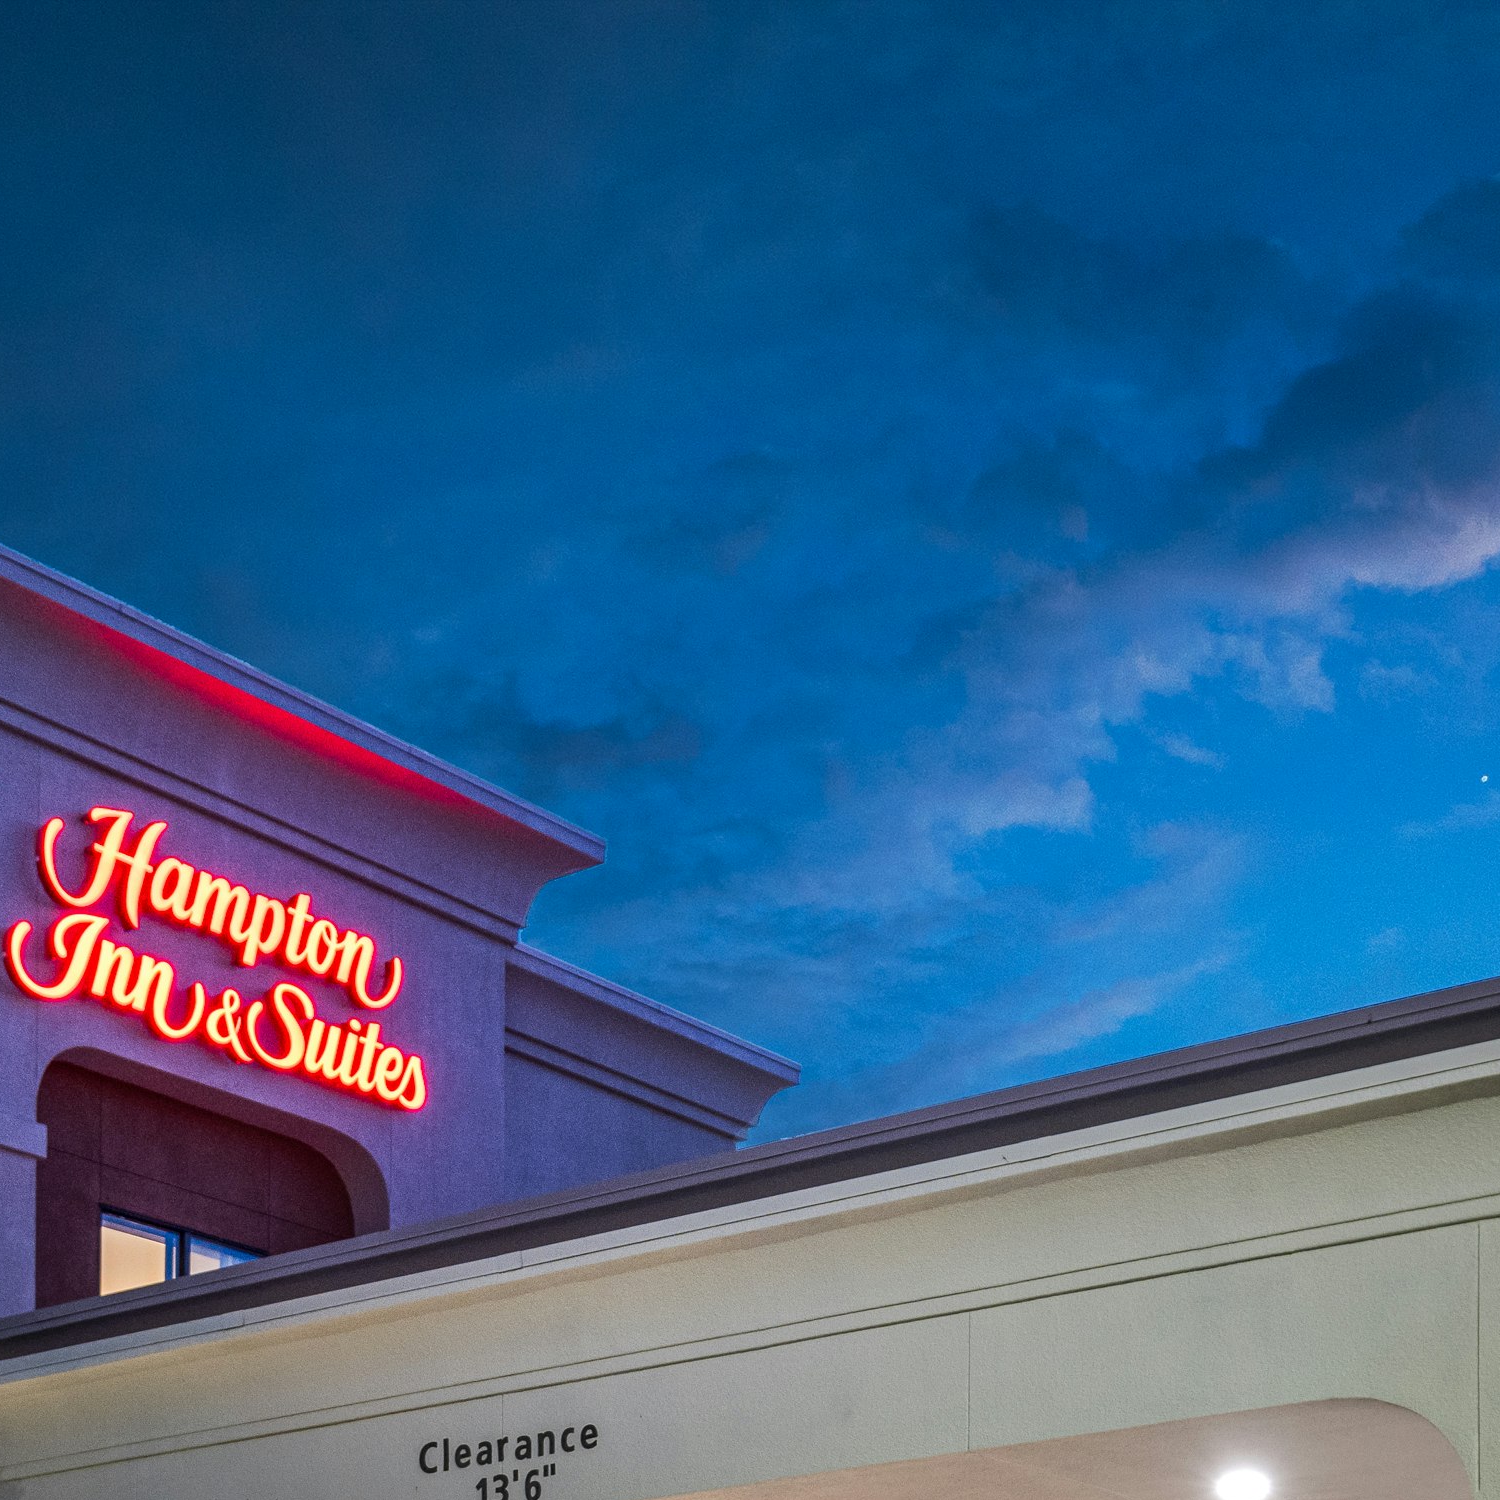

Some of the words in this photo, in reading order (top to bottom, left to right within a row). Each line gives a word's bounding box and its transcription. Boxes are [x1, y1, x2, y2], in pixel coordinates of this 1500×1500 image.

[42, 807, 404, 1009] Hampton
[8, 914, 205, 1039] Inn
[206, 988, 254, 1063] &
[247, 983, 429, 1111] Suites
[419, 1424, 598, 1474] Clearance
